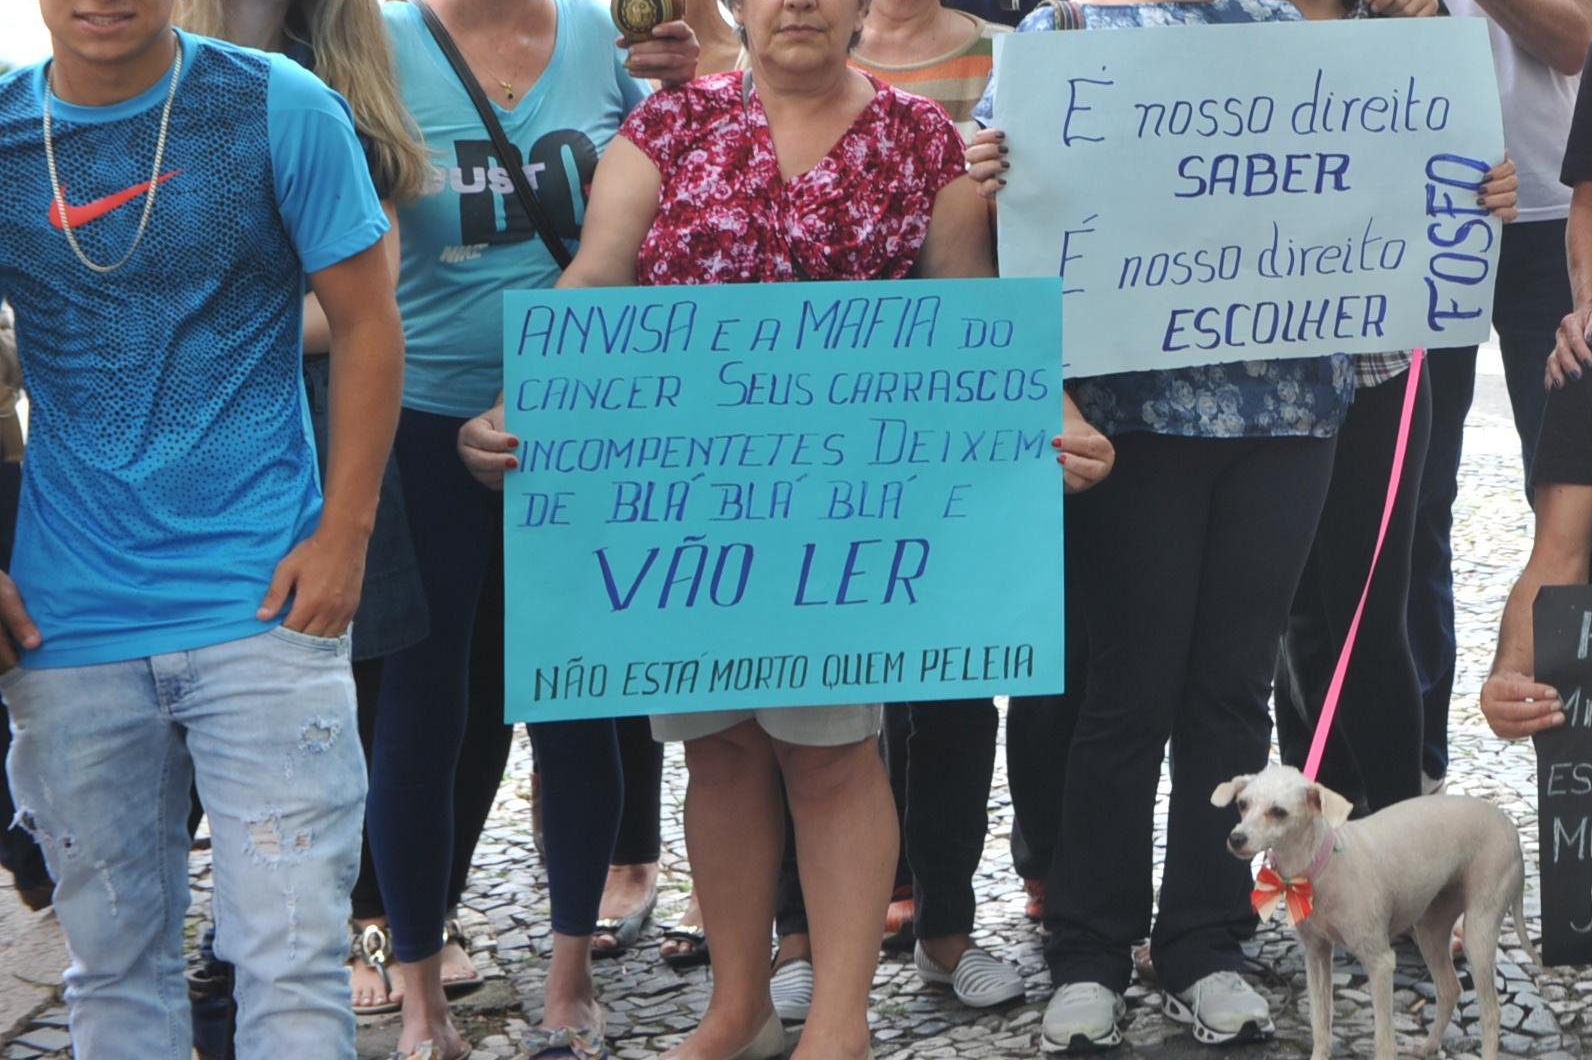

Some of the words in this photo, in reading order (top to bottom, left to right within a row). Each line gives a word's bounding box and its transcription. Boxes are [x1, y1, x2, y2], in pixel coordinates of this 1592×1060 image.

[1134, 95, 1274, 138] nosso
[1291, 69, 1450, 135] direito
[1174, 153, 1351, 198] SABER
[1118, 245, 1241, 289] nosso
[1258, 217, 1405, 278] direito
[1423, 153, 1494, 332] FOSFO
[517, 300, 697, 356] ANVISA
[710, 318, 740, 352] E
[750, 318, 782, 352] A
[796, 295, 941, 350] MAFIA
[958, 317, 1014, 350] DO
[1162, 294, 1387, 352] ESCOLHER
[516, 374, 682, 412] CANCER
[717, 360, 814, 407] SEUS
[828, 368, 1048, 405] CARRASCOS
[518, 432, 846, 474] INCOMPENTETES
[867, 417, 1047, 467] DEIXEM
[517, 492, 576, 528] DE
[605, 473, 705, 524] BLÁ
[709, 474, 809, 522] BLÁ
[817, 474, 918, 521] BLÁ
[942, 484, 972, 519] E
[592, 535, 755, 614] VÃO
[793, 537, 931, 607] LER
[533, 656, 608, 701] NÃO
[622, 651, 709, 697] ESTÁ
[709, 654, 808, 694] MORTO
[822, 651, 904, 690] QUEM
[919, 643, 1035, 683] PELEIA
